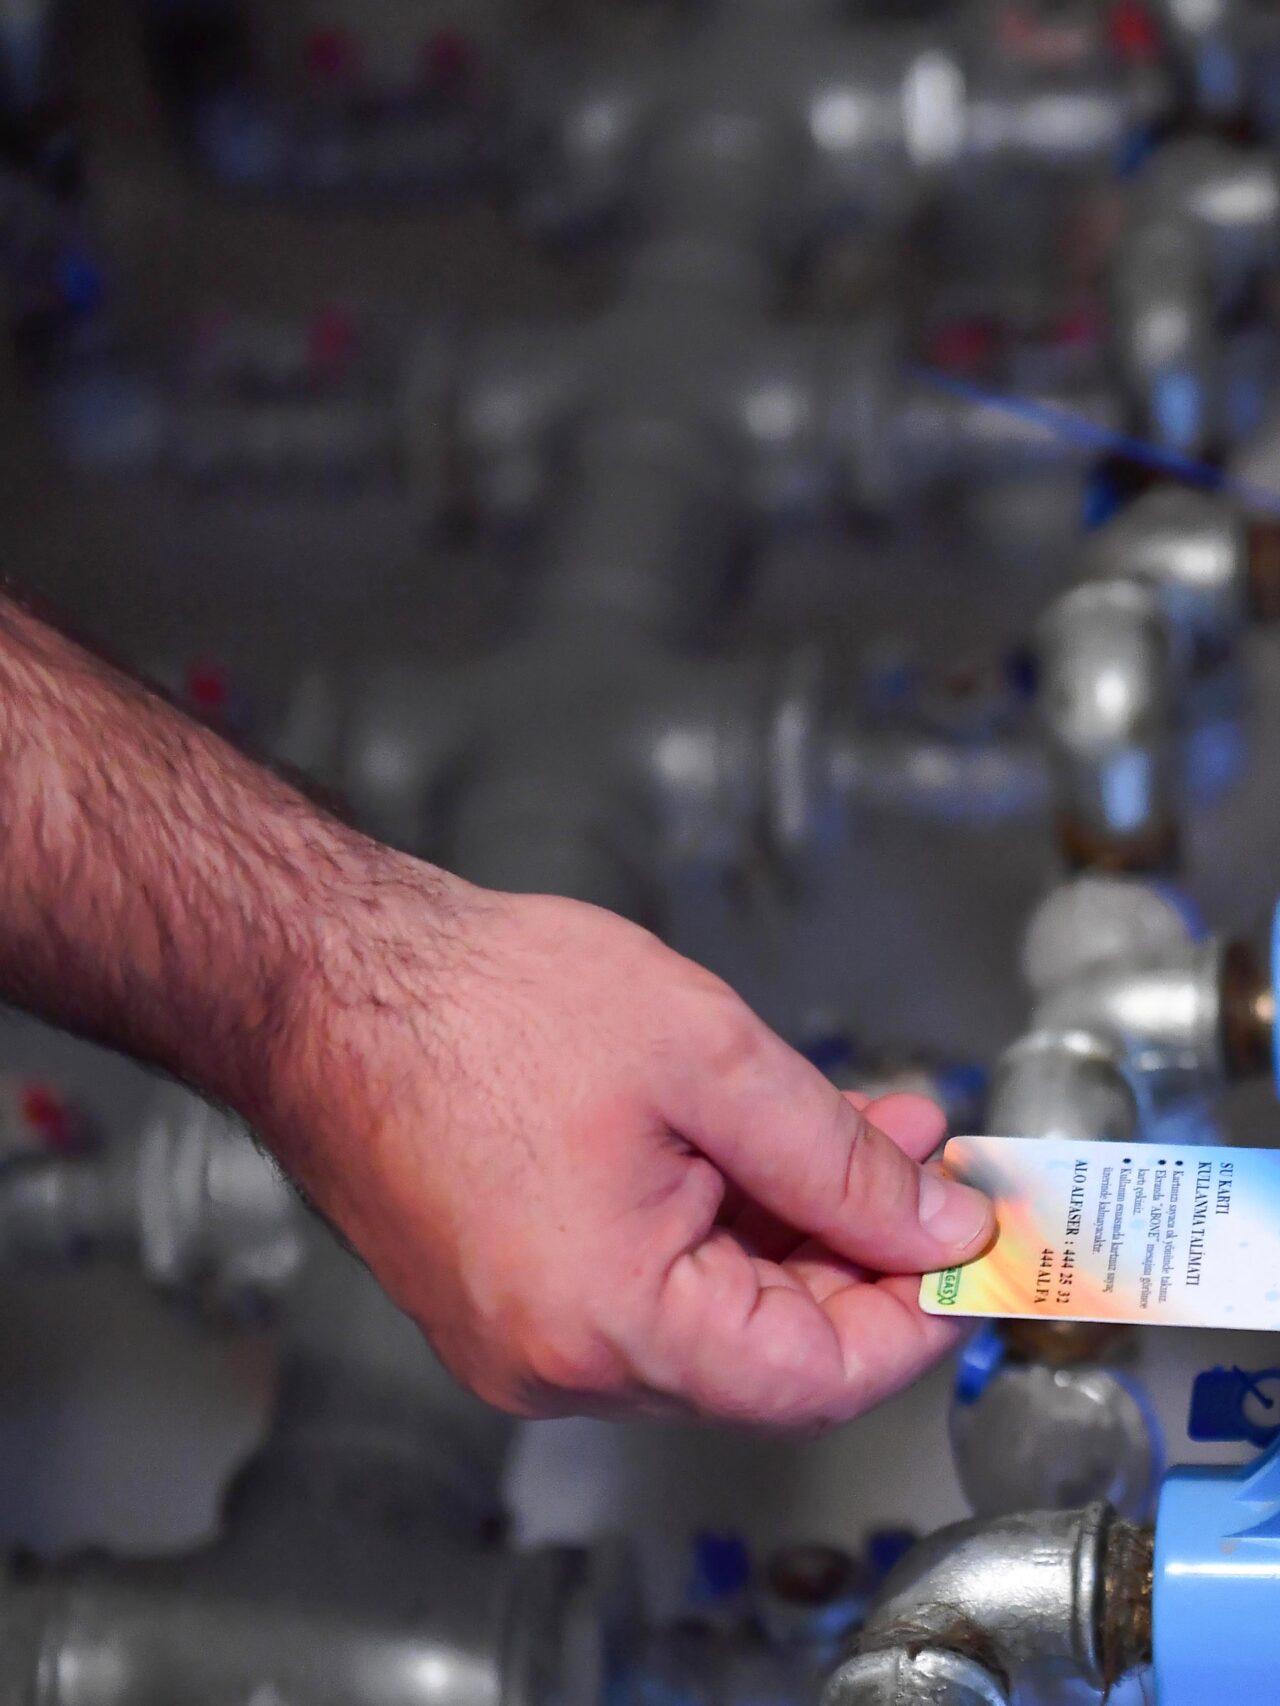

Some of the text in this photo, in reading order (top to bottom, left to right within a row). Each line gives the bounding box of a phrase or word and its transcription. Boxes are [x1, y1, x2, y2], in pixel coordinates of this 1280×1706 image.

[1073, 1160, 1088, 1183] ALO
[1216, 1162, 1234, 1214] SU KARTI
[1066, 1186, 1084, 1236] ALFASER
[1186, 1162, 1212, 1286] KULLANMA TALİMATI
[1040, 1248, 1054, 1267] 444
[1061, 1249, 1076, 1268] 444
[1059, 1272, 1073, 1285] 25
[1056, 1290, 1071, 1303] 32
